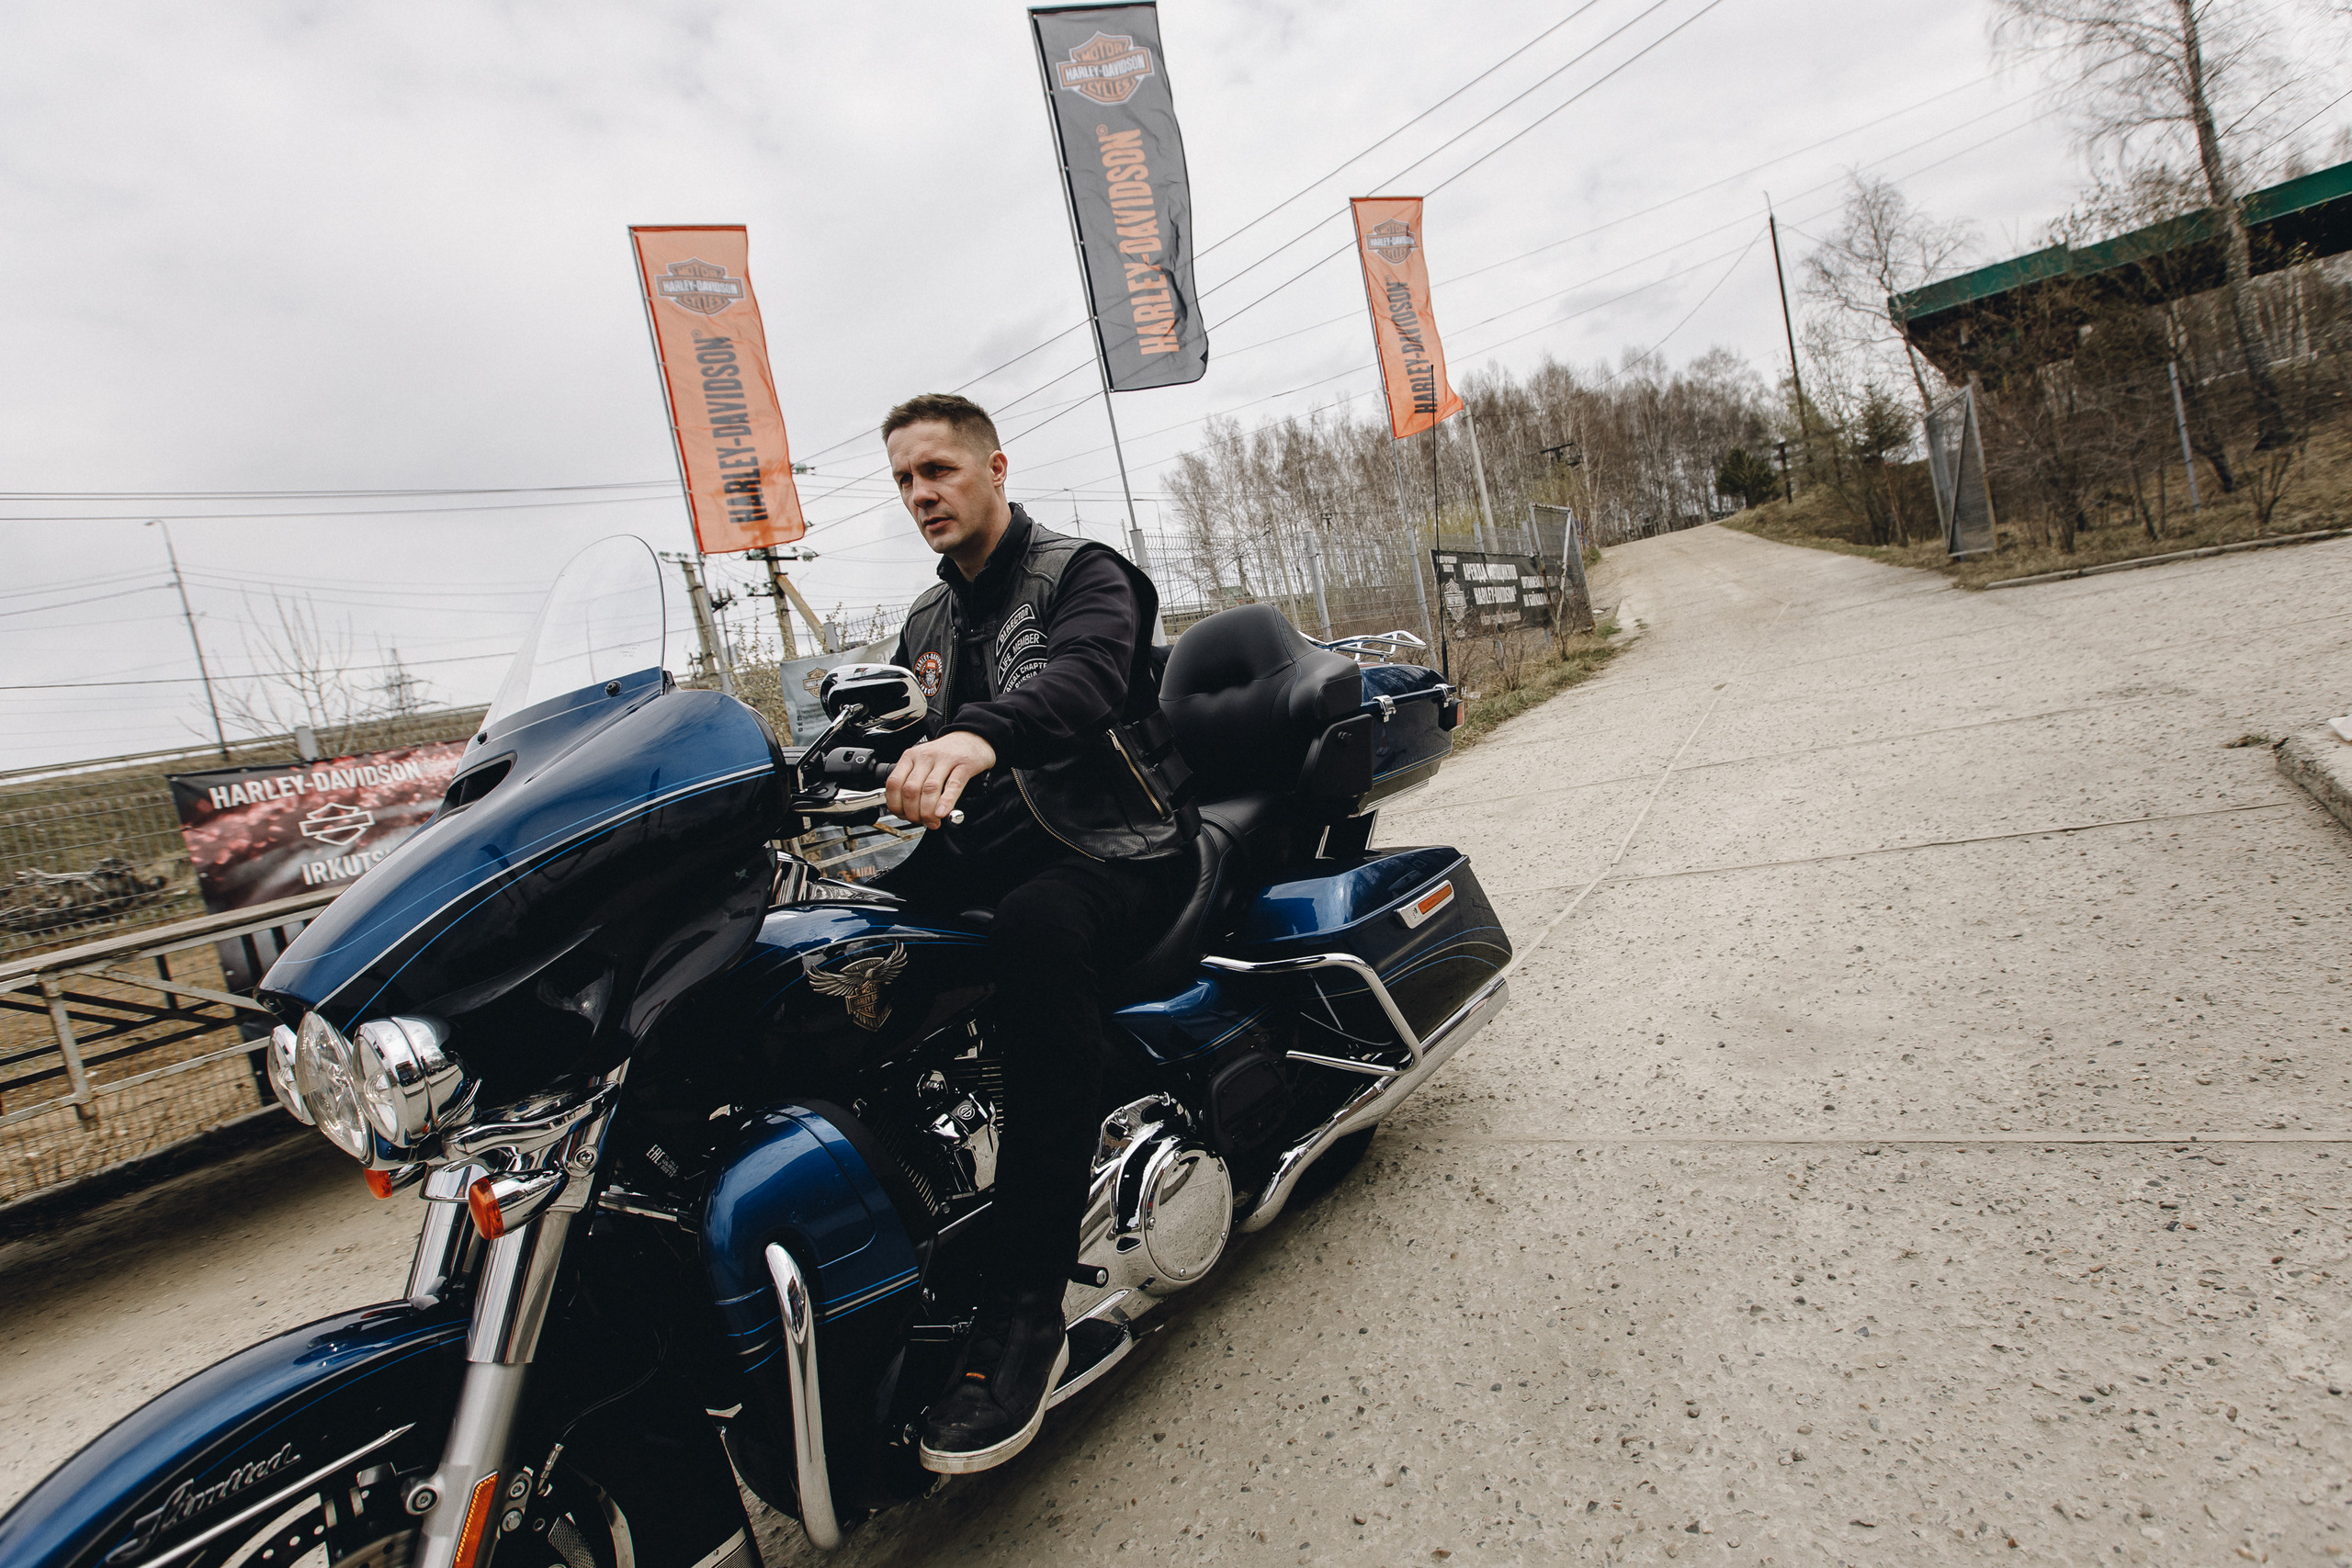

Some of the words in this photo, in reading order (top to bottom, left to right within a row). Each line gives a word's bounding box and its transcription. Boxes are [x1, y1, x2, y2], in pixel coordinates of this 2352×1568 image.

[1065, 53, 1146, 82] HARLEY-DAVIDSON
[1081, 41, 1123, 61] MOTOR
[1088, 79, 1131, 96] CYCLES
[1098, 128, 1180, 355] HARLEY-DAVIDSON
[662, 279, 738, 295] HARLEY-DAVIDSON
[694, 337, 768, 524] HARLEY-DAVIDSON
[999, 607, 1029, 643] DIRECTOR
[1000, 652, 1012, 672] LIFE
[1012, 633, 1040, 654] MEMBER
[1006, 672, 1021, 693] AIKAL
[1020, 662, 1047, 674] CHAPTE
[208, 762, 423, 809] HARLEY-DAVIDSON
[301, 849, 391, 886] IRKUTS
[861, 982, 877, 994] MOTO
